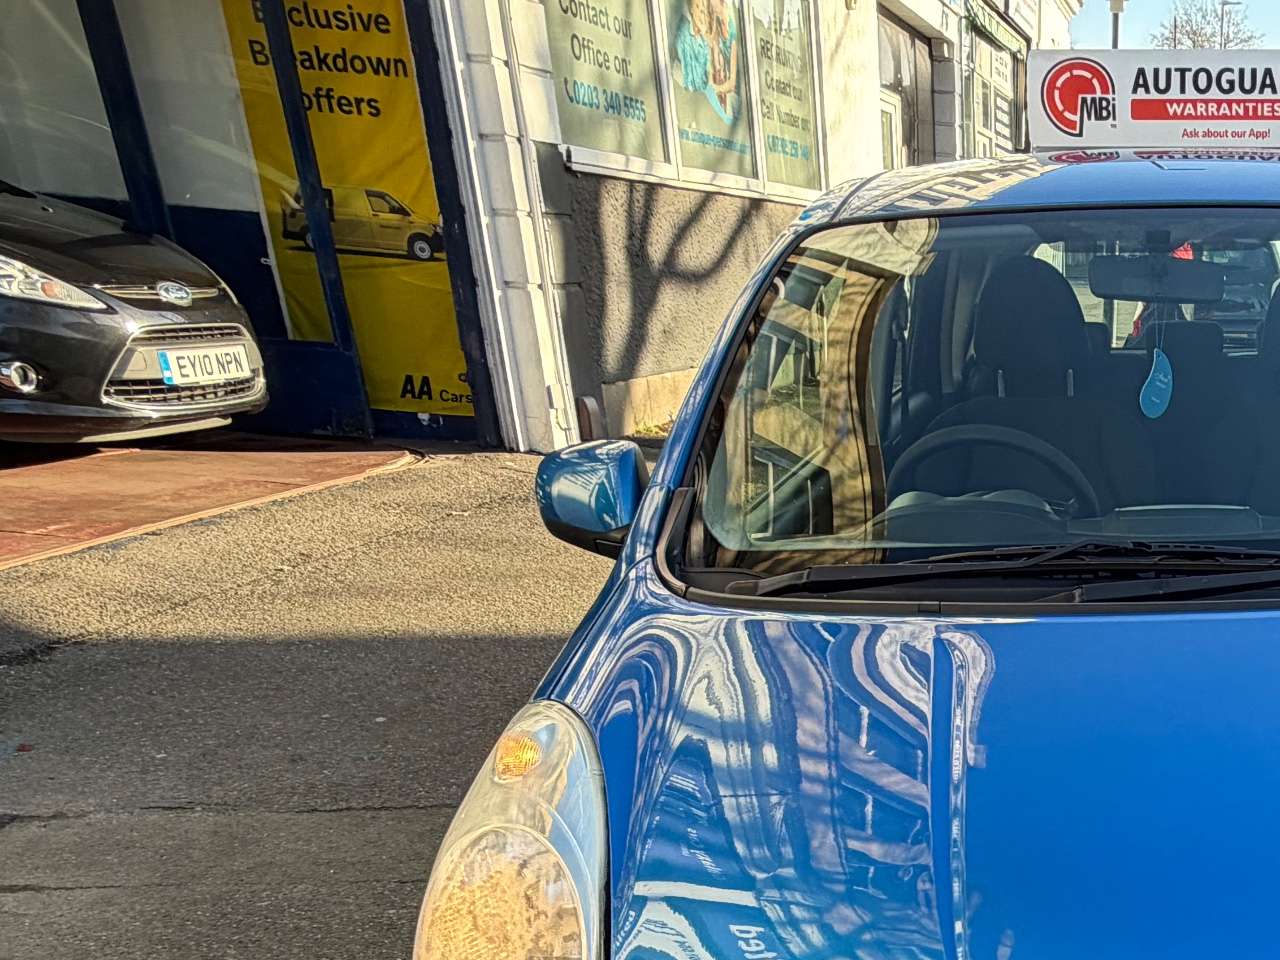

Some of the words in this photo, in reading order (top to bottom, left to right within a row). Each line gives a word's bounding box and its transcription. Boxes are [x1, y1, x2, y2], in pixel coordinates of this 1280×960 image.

[613, 15, 632, 40] our
[248, 39, 409, 78] Bakdown
[570, 33, 610, 71] Office
[614, 55, 633, 78] on:
[573, 79, 600, 110] 0203
[603, 89, 622, 116] 340
[623, 95, 647, 123] 5555
[1079, 96, 1117, 122] MBi
[1181, 128, 1200, 138] Ask
[1201, 128, 1229, 138] about
[1231, 130, 1246, 138] our
[1248, 128, 1271, 141] App!
[175, 353, 214, 378] EY10
[215, 351, 245, 375] NPN
[400, 374, 433, 401] AA
[440, 389, 472, 404] Cars
